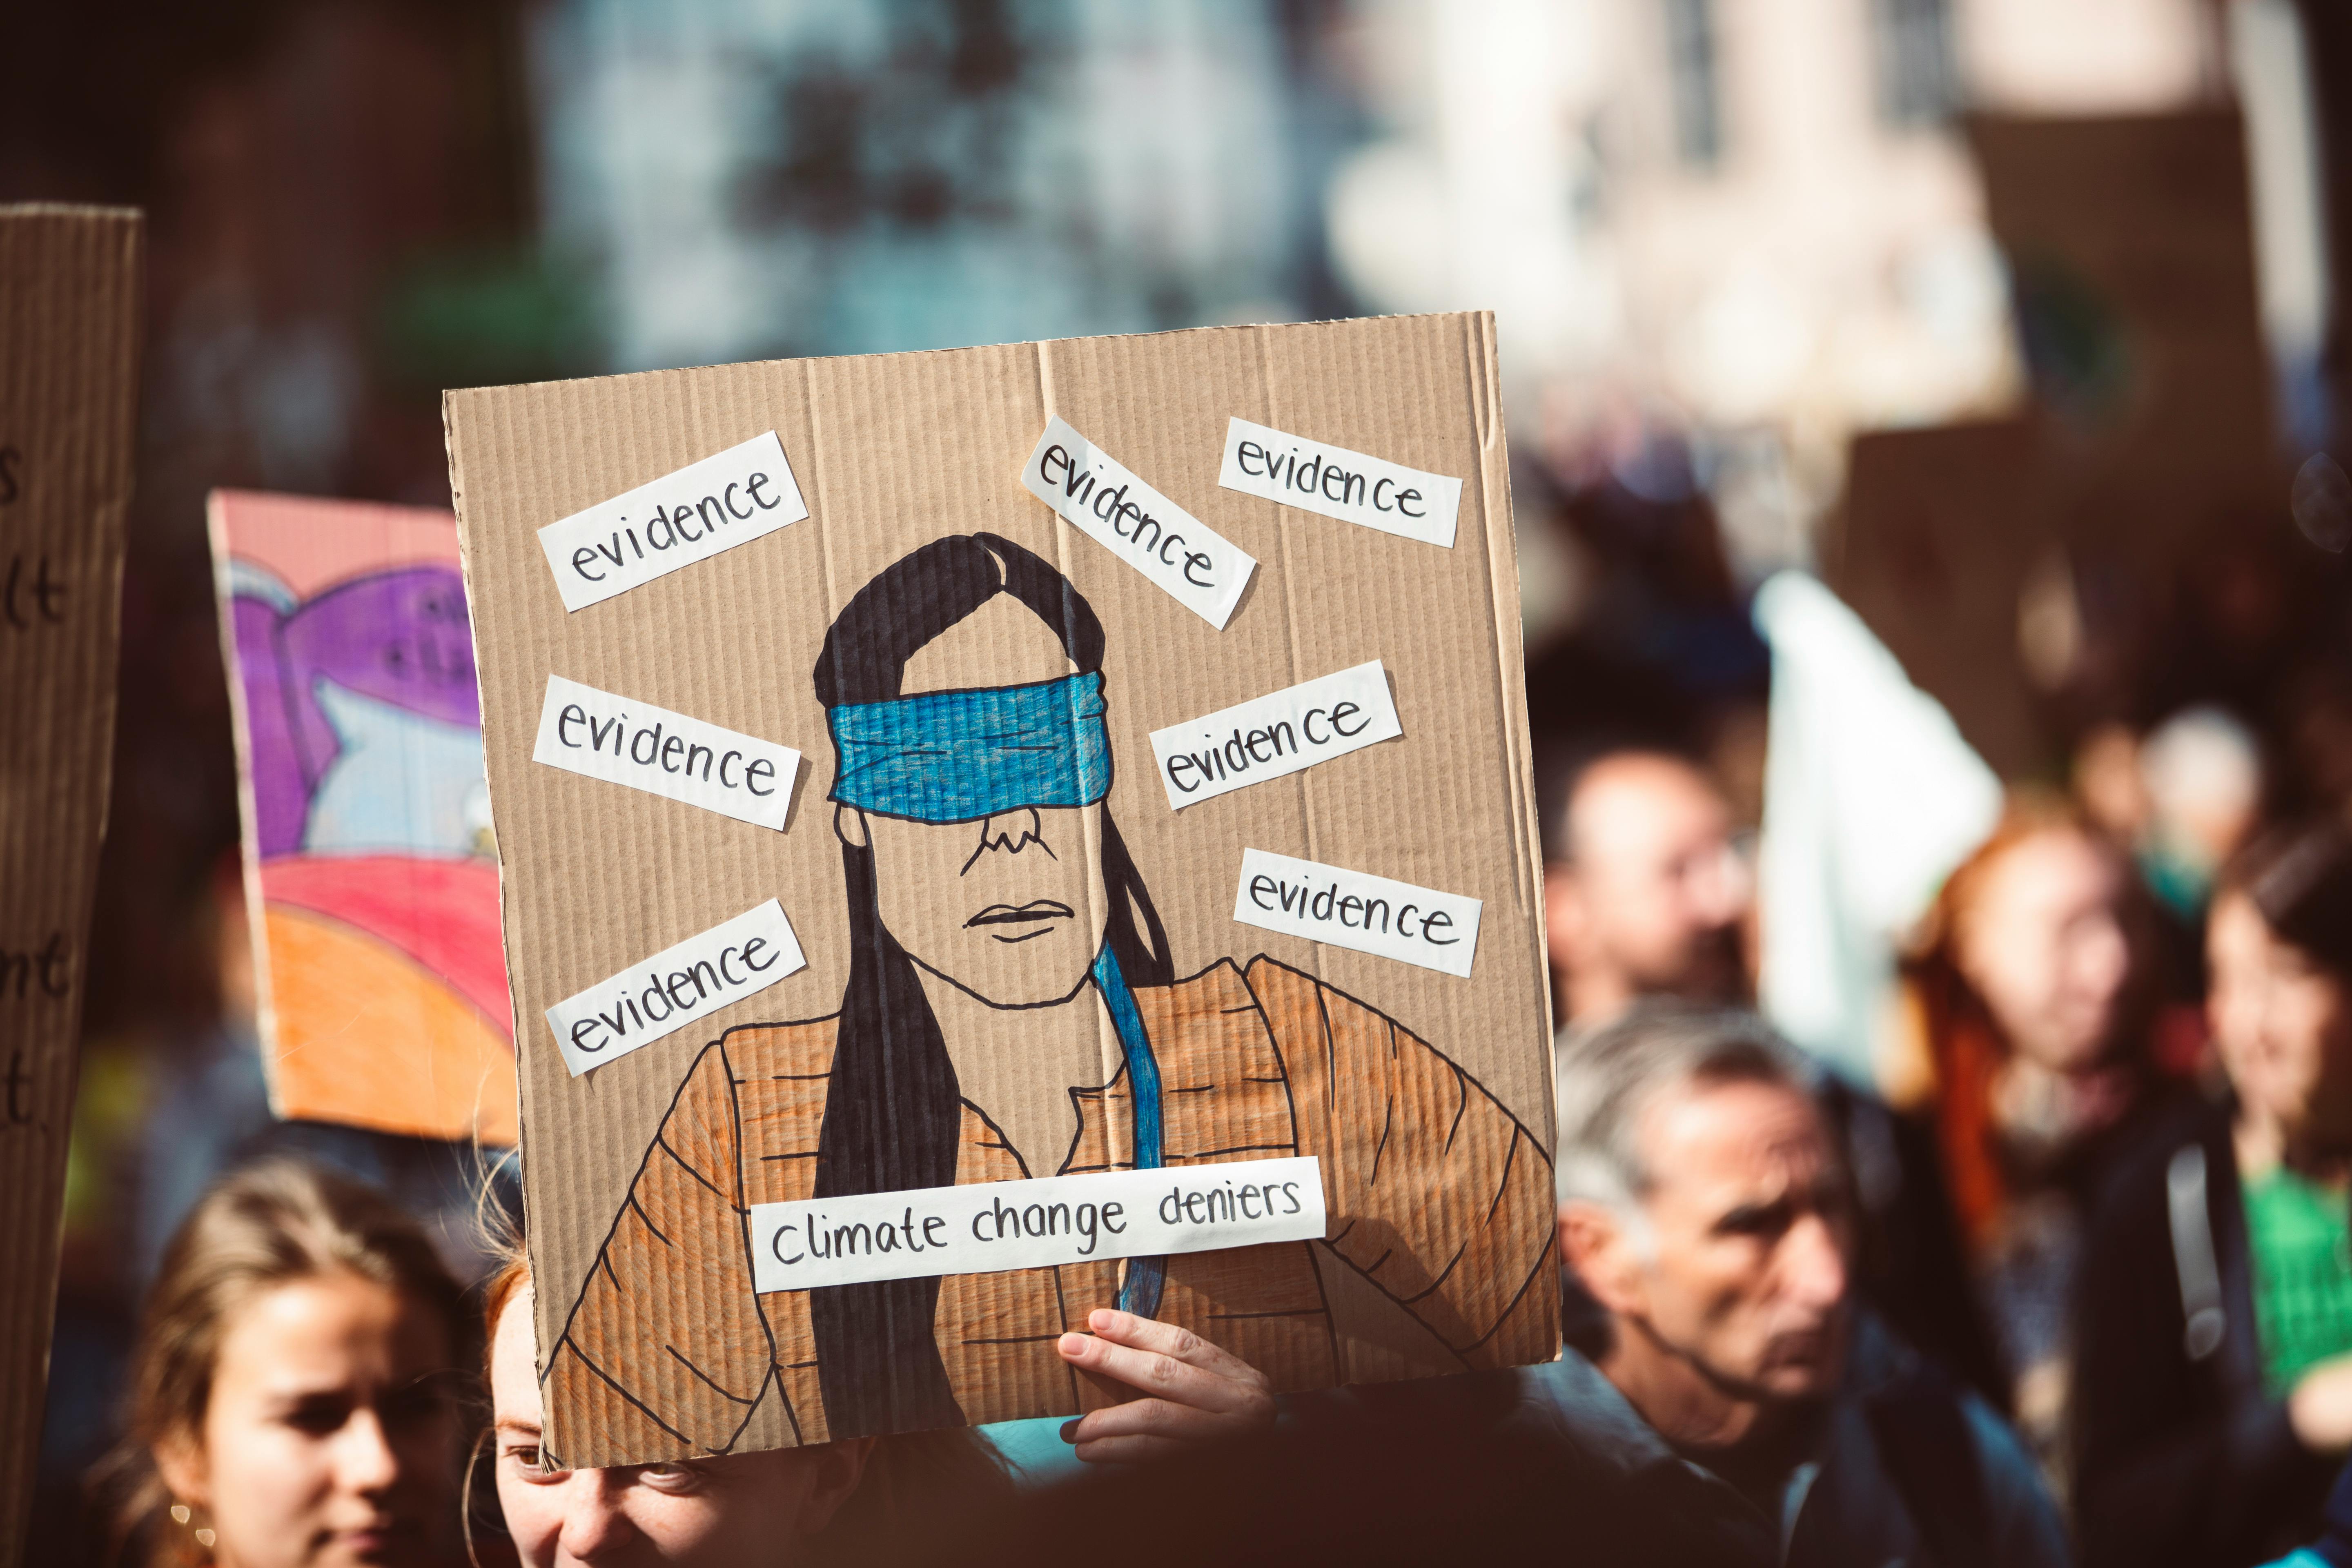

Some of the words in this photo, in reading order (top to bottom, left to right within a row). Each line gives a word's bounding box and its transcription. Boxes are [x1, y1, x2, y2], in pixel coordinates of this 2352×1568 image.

[1040, 444, 1215, 588] evidence
[1238, 441, 1426, 518] evidence
[572, 472, 781, 581] evidence
[558, 704, 775, 797] evidence
[1167, 702, 1372, 793] evidence
[1250, 874, 1460, 946] evidence
[571, 937, 780, 1053] evidence
[972, 1196, 1127, 1255] change
[1159, 1181, 1301, 1225] deniers
